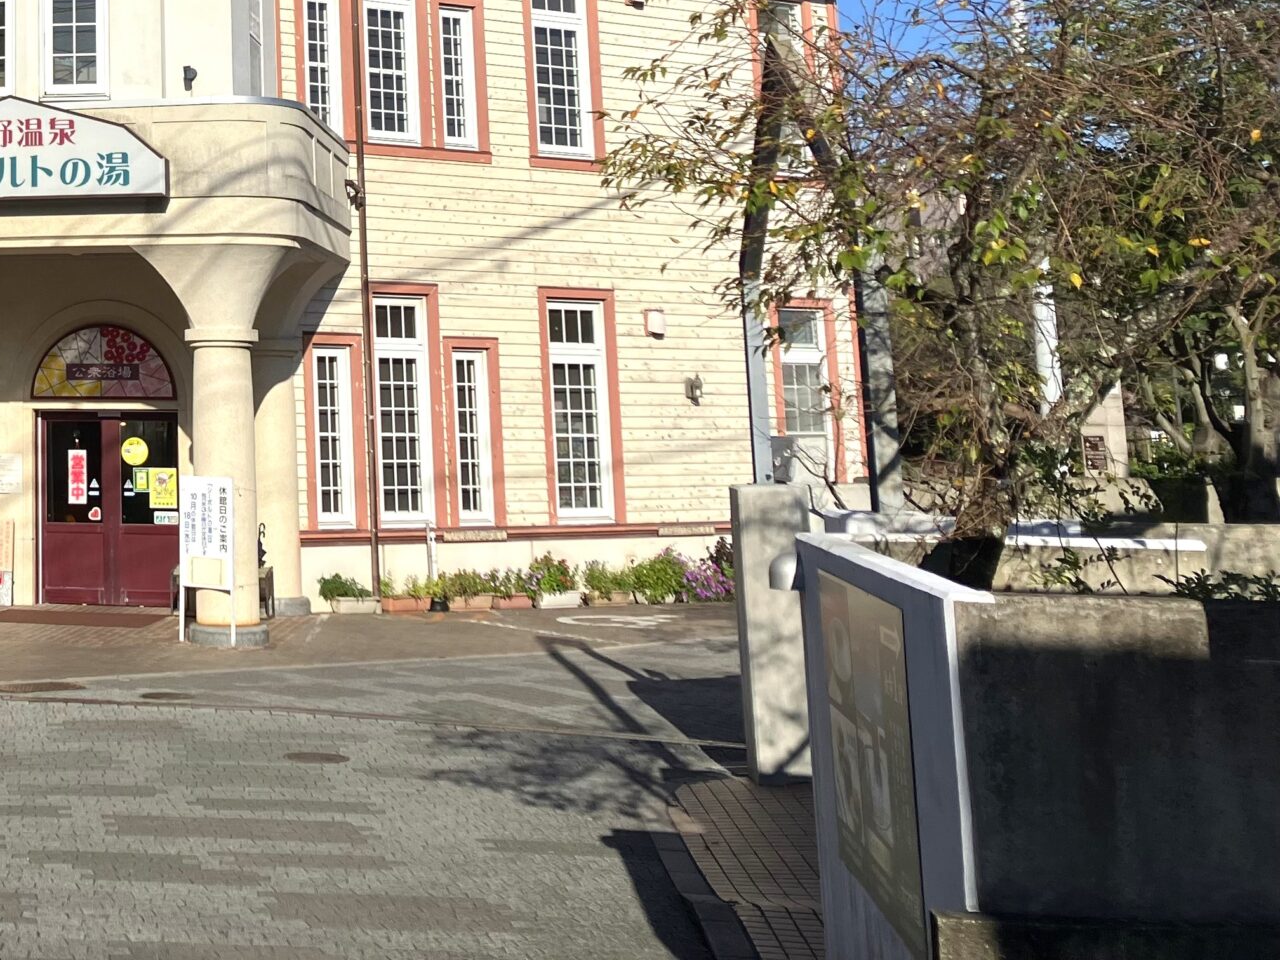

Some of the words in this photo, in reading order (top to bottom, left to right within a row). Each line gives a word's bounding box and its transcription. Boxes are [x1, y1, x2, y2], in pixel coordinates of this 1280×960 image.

[71, 365, 132, 378] 公衆浴場
[71, 454, 85, 501] 営業中
[218, 487, 228, 553] 休館日のご案内
